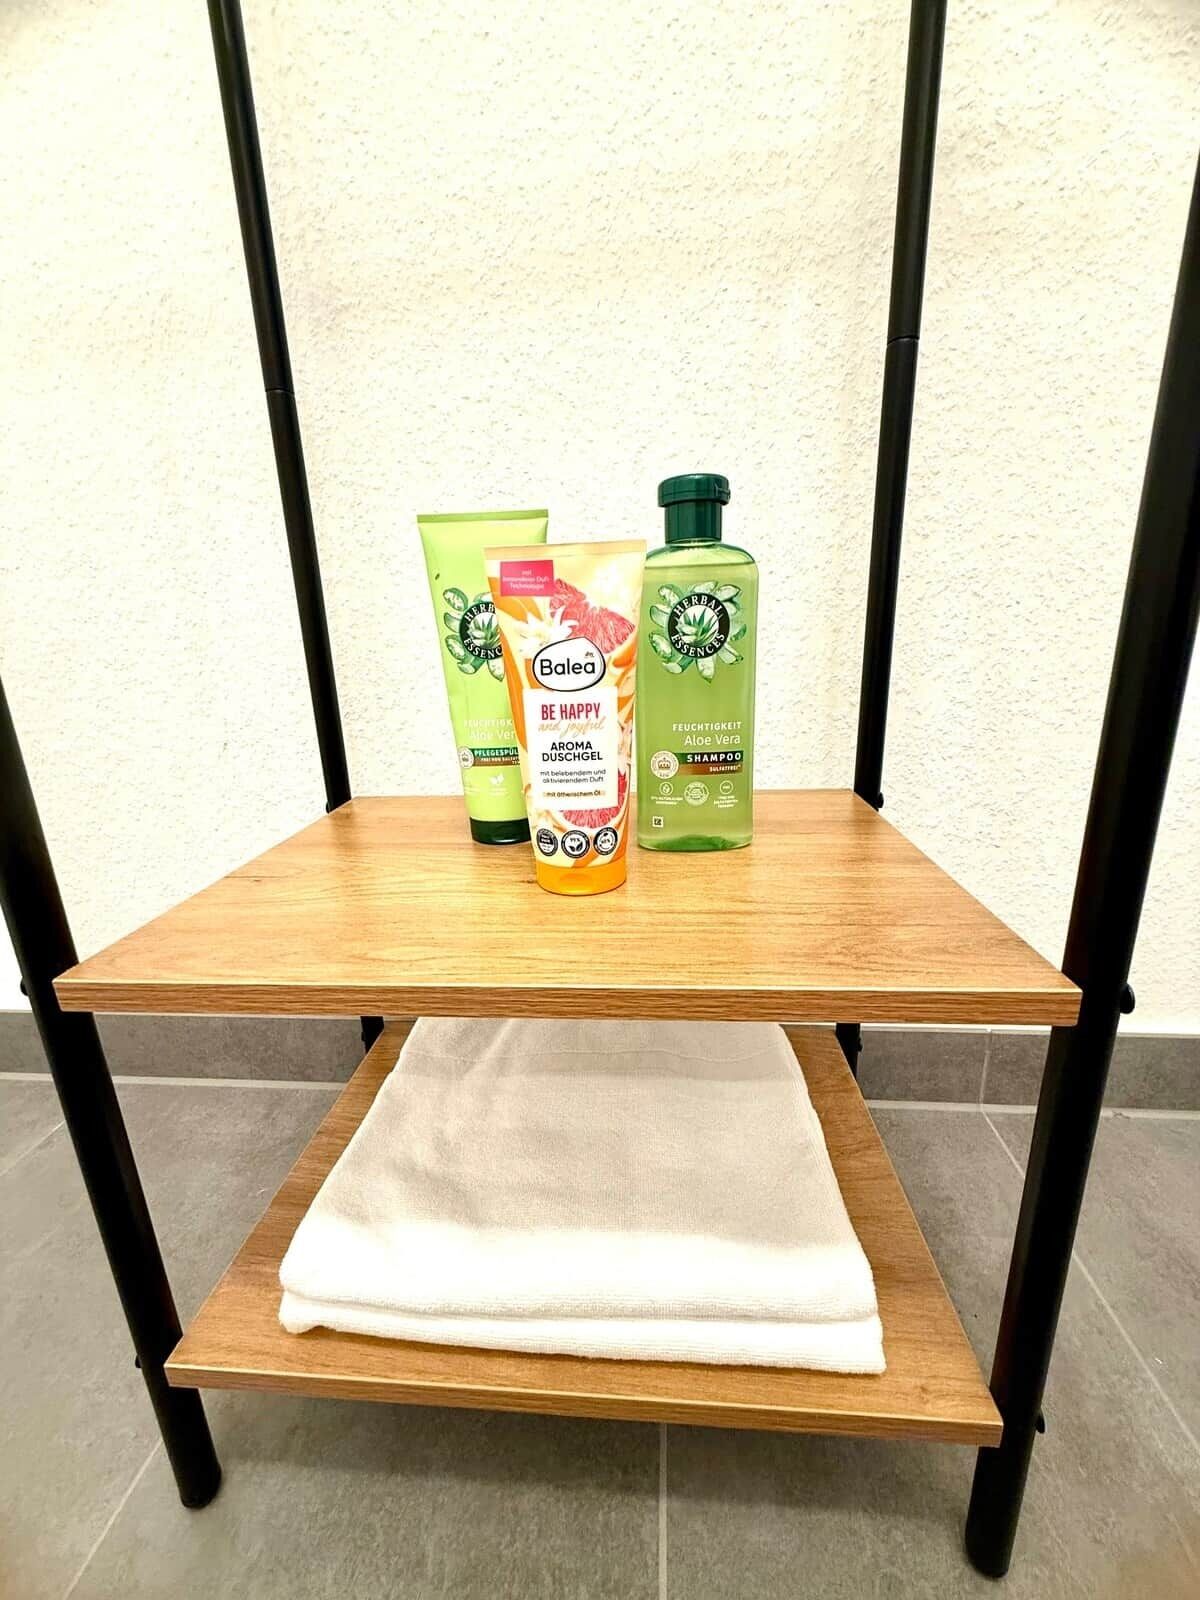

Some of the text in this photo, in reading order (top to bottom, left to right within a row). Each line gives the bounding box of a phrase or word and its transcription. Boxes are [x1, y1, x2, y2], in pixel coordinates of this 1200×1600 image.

[464, 603, 494, 621] HERB
[673, 595, 724, 618] HERBAL
[464, 638, 503, 659] ESSENC
[671, 634, 725, 657] ESSENCES
[540, 658, 596, 676] Balea
[541, 702, 600, 720] BE HAPPY
[464, 719, 513, 728] FEUCHTIGK
[538, 716, 606, 739] and joyful
[672, 722, 742, 732] FEUCHTIGKEIT
[496, 729, 515, 740] Ver
[684, 734, 741, 746] Aloe Vera
[474, 748, 519, 757] PFLEGESPÜL
[550, 741, 593, 752] AROMA
[541, 751, 603, 762] DUSCHGEL
[687, 752, 741, 763] SHAMPOO
